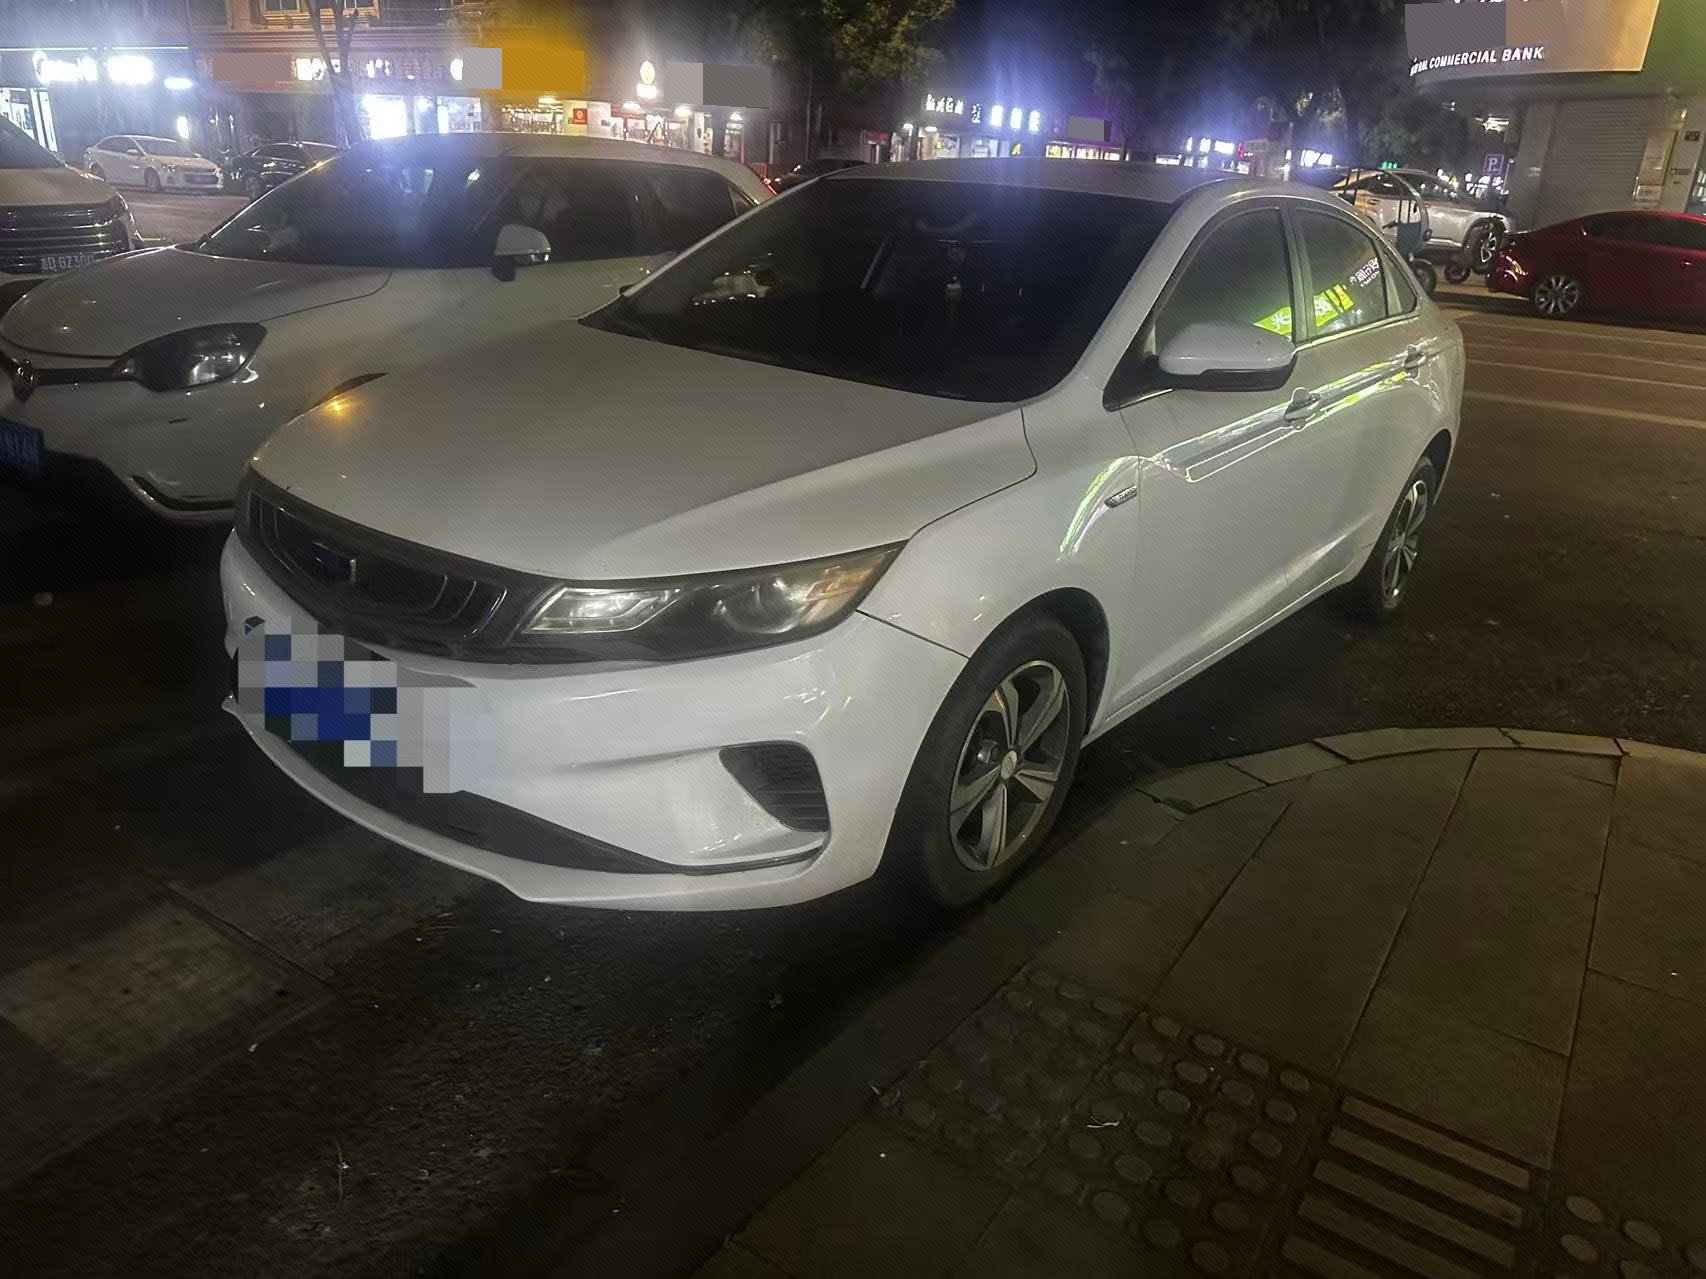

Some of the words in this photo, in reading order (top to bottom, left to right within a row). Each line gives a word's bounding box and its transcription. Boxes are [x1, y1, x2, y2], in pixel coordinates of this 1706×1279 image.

[1429, 50, 1497, 69] COMMERCIAL
[1502, 46, 1544, 62] BANK
[1487, 157, 1498, 172] P
